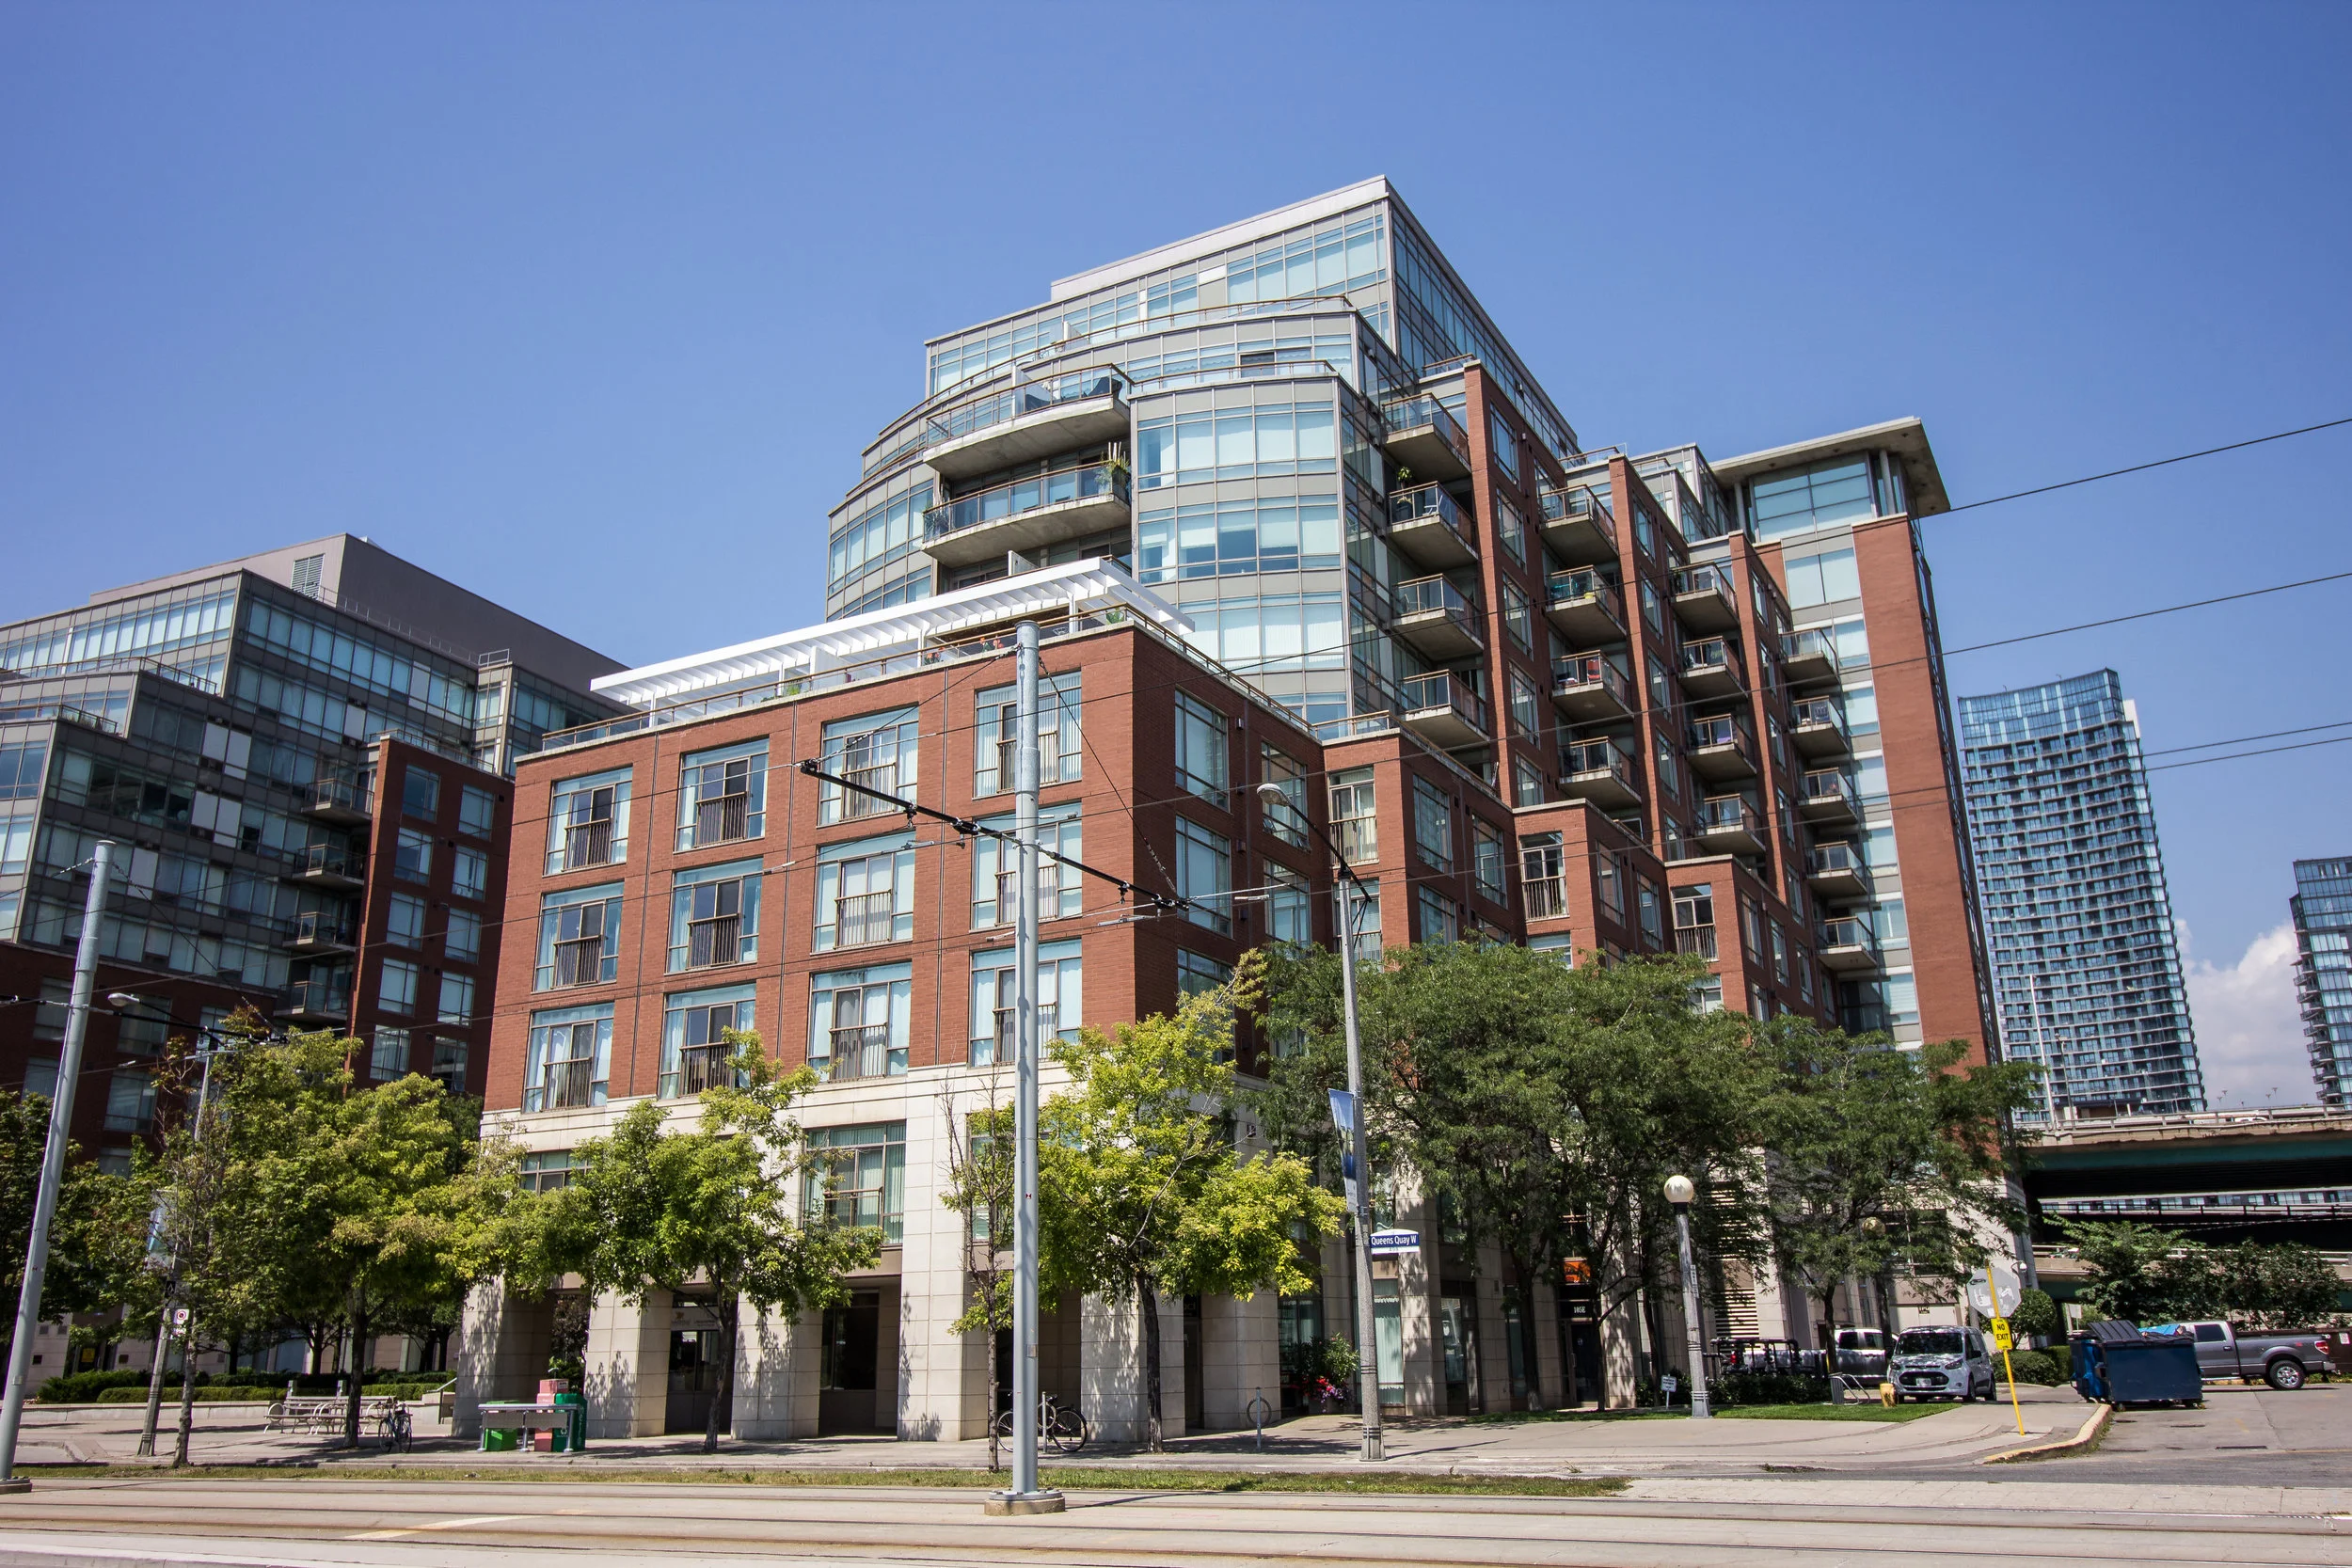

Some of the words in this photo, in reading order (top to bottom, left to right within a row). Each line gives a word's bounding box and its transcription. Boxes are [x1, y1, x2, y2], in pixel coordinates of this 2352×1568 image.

[1371, 1236, 1393, 1245] Queens
[1394, 1235, 1410, 1246] Quay
[1411, 1235, 1417, 1243] W
